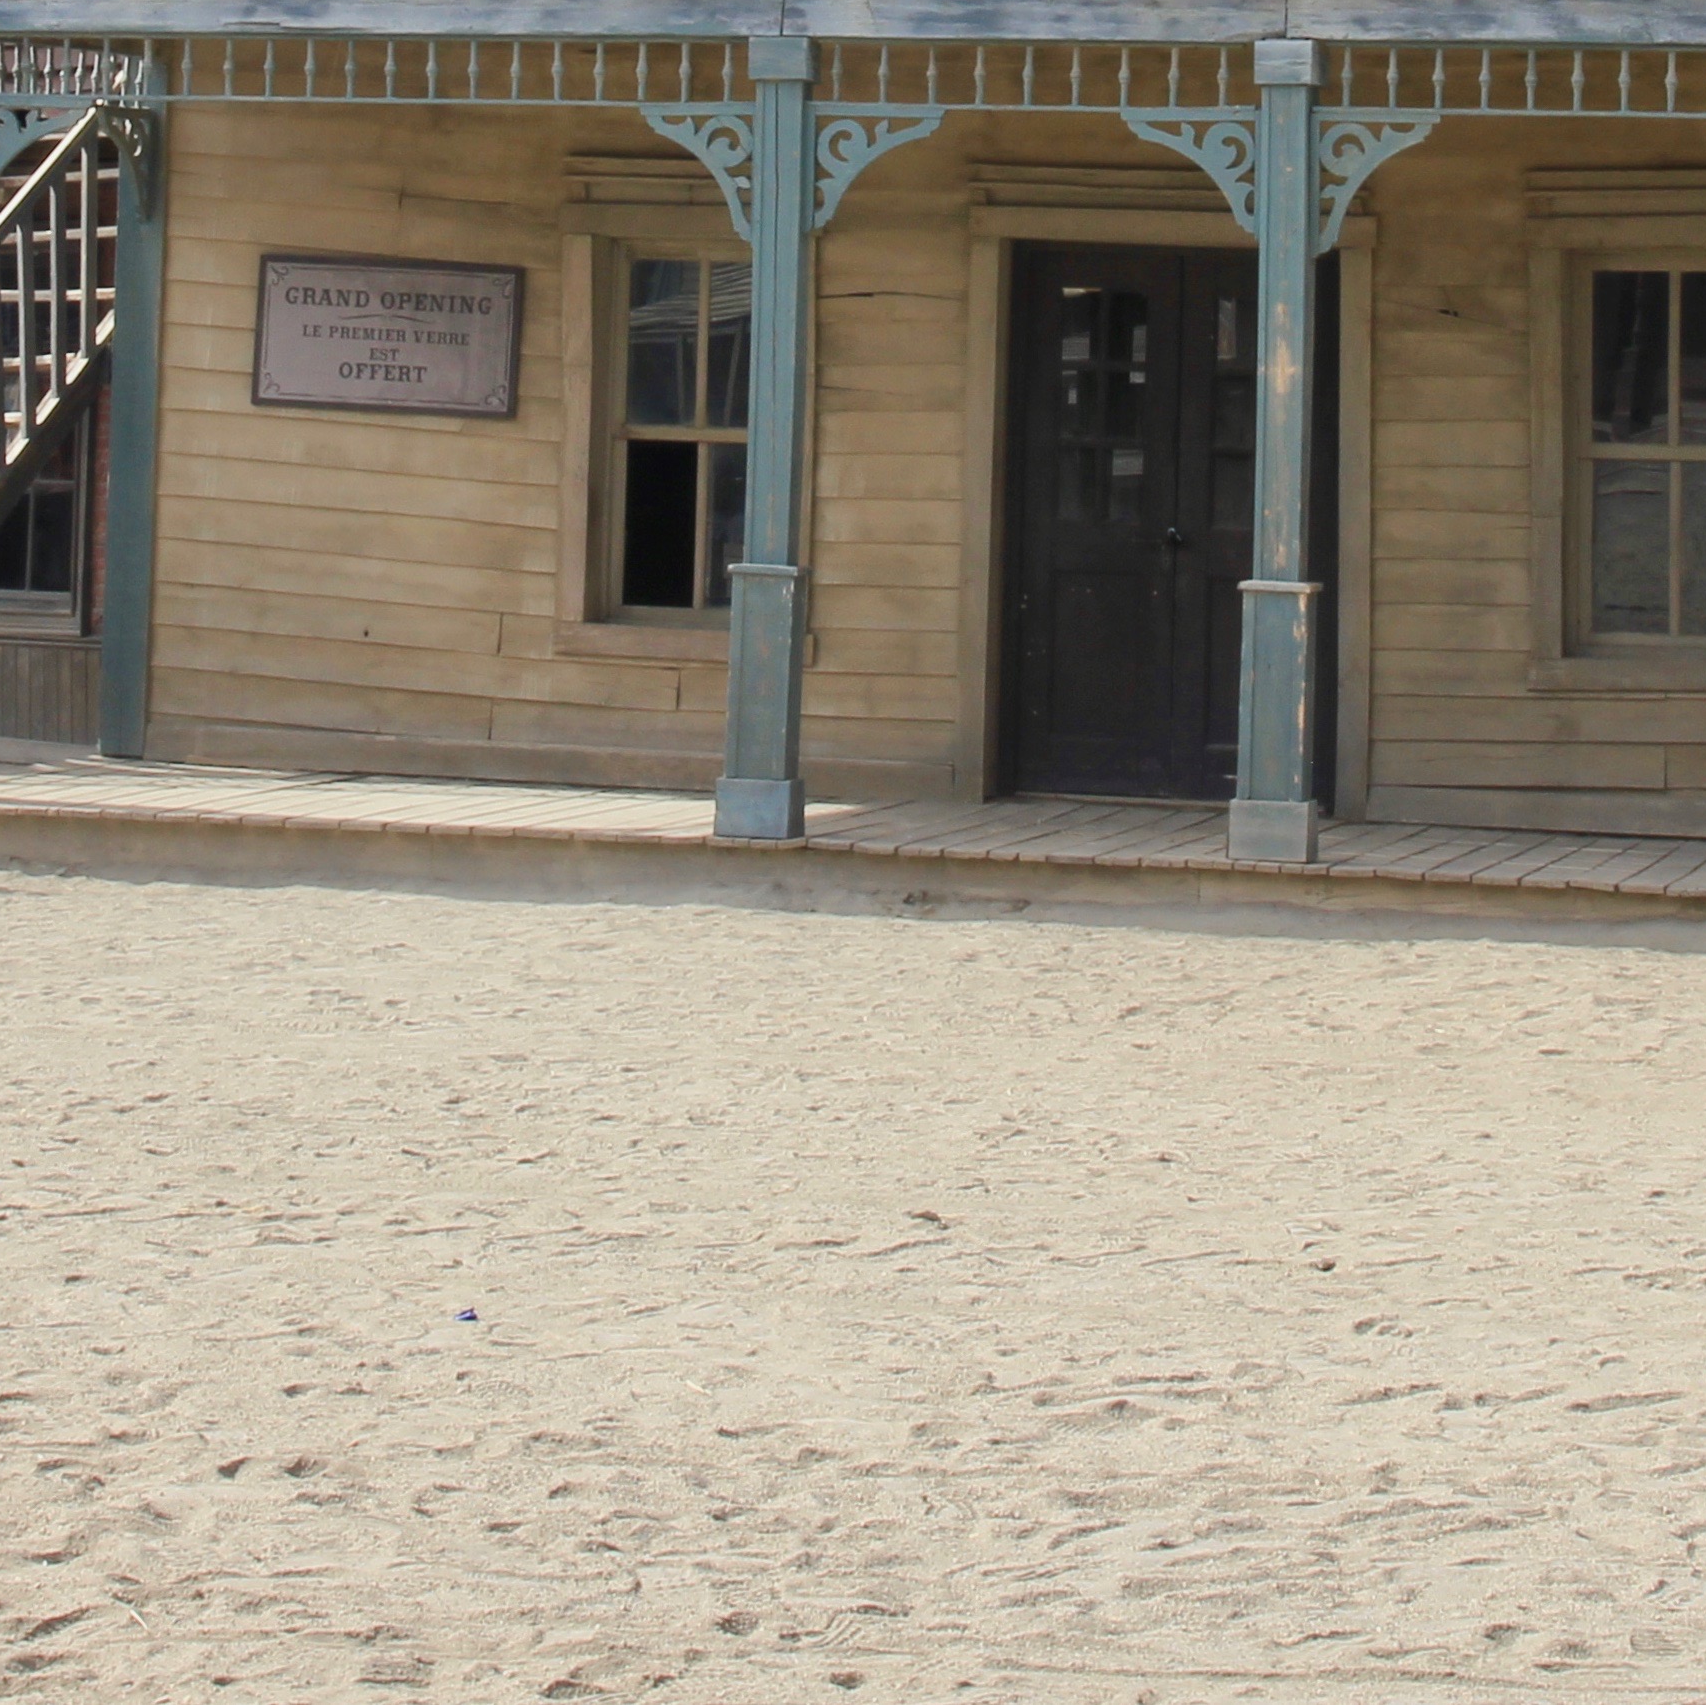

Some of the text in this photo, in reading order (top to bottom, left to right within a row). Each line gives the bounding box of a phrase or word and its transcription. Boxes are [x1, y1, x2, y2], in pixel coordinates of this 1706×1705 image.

[284, 286, 493, 315] GRAND OPENING
[302, 324, 470, 346] LE PREMIER VERRE
[368, 347, 400, 361] EST
[338, 362, 428, 383] OFFERT
